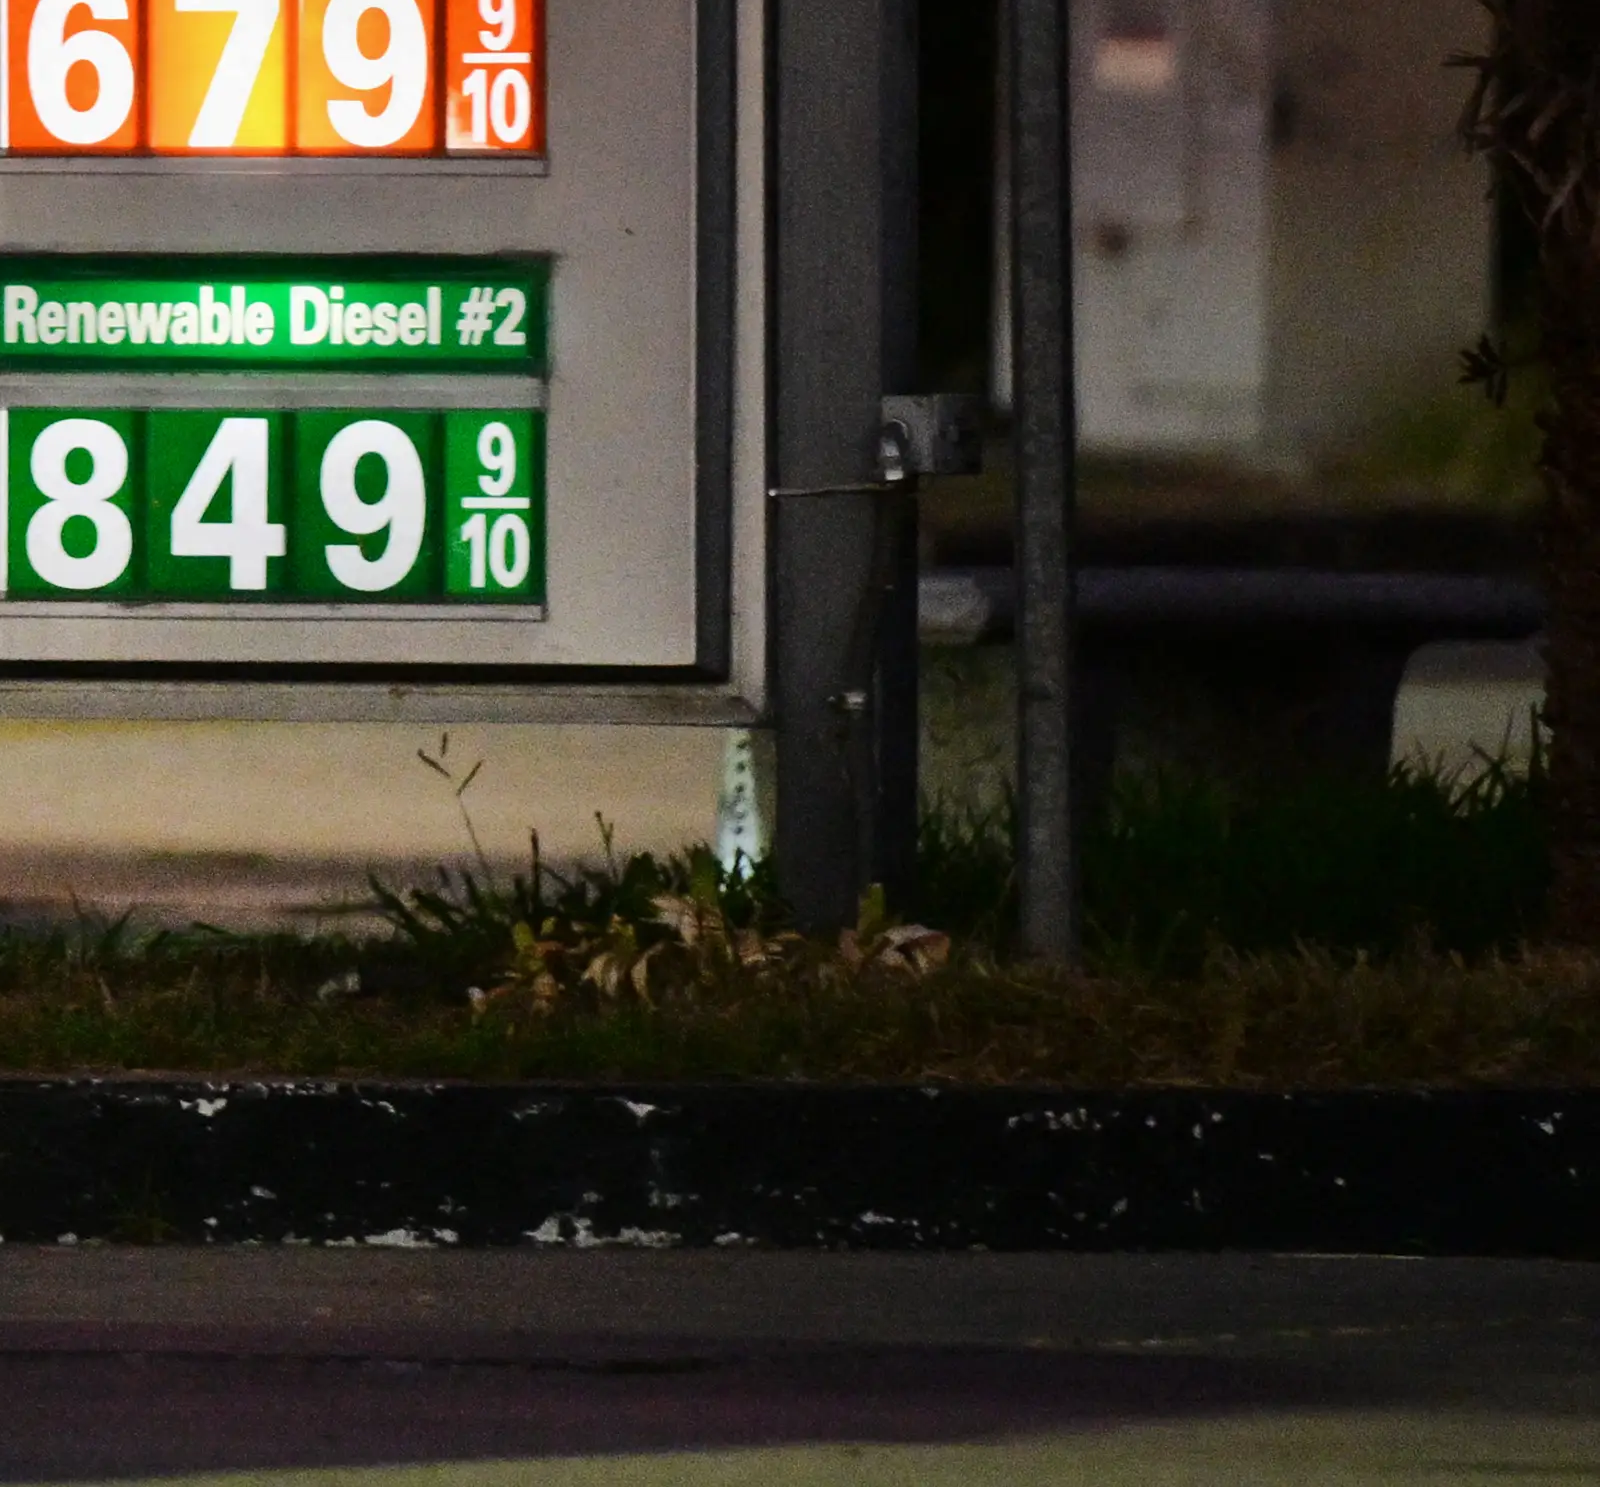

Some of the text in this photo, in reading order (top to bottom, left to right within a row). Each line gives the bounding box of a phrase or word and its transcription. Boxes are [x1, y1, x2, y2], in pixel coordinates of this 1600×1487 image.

[462, 68, 531, 143] 10
[3, 285, 526, 346] Renewable Diesel #2
[476, 421, 516, 497] 9
[25, 418, 427, 591] 849
[460, 513, 531, 589] 10
